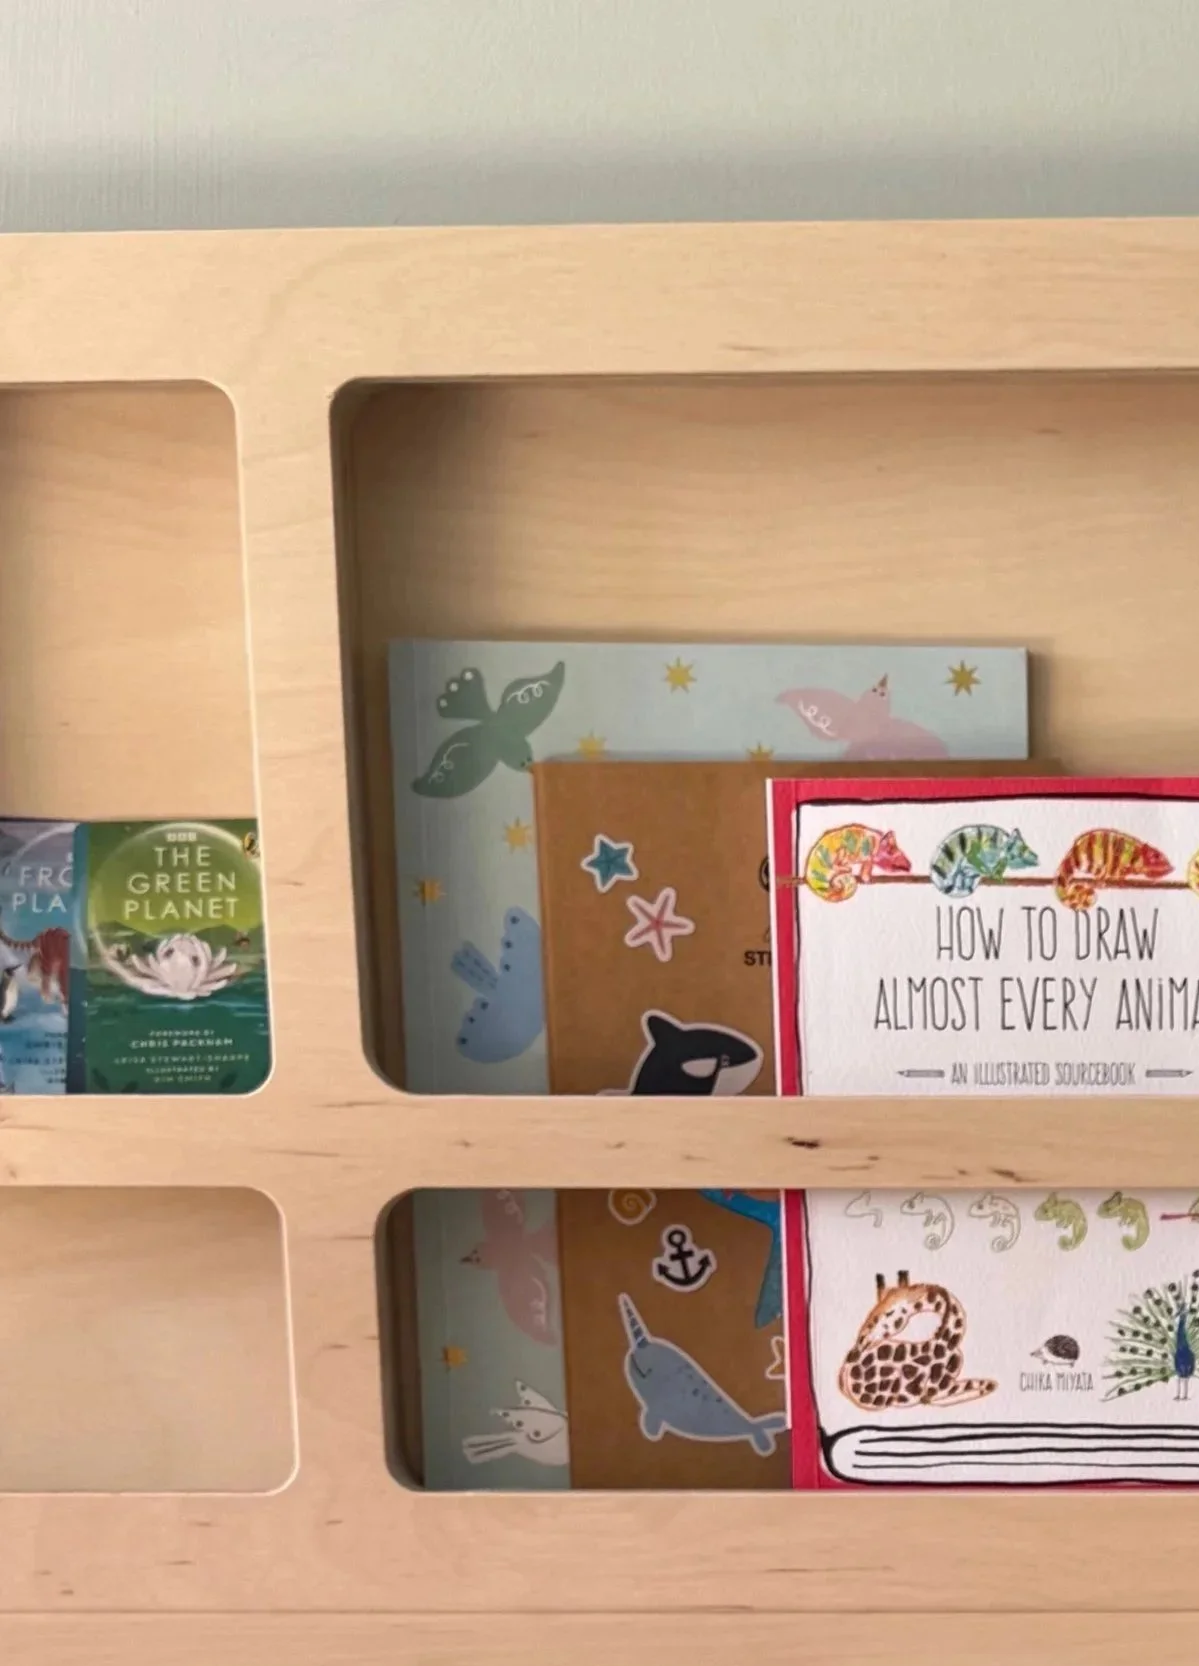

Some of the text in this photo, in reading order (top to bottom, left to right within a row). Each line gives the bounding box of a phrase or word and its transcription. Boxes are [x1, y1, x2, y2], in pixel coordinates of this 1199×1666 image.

[152, 845, 212, 868] THE
[127, 871, 236, 894] GREEN
[124, 897, 239, 920] PLANET
[936, 904, 1159, 962] HOW TO DRAW
[874, 976, 983, 1031] ALMOST
[1000, 976, 1098, 1031] EVERY
[129, 1037, 234, 1049] CHRIS PACKHAM
[951, 1062, 1136, 1087] AN ILLUSTRATED SOURCEBOOK
[1020, 1372, 1093, 1391] CHIKA MIYATA
